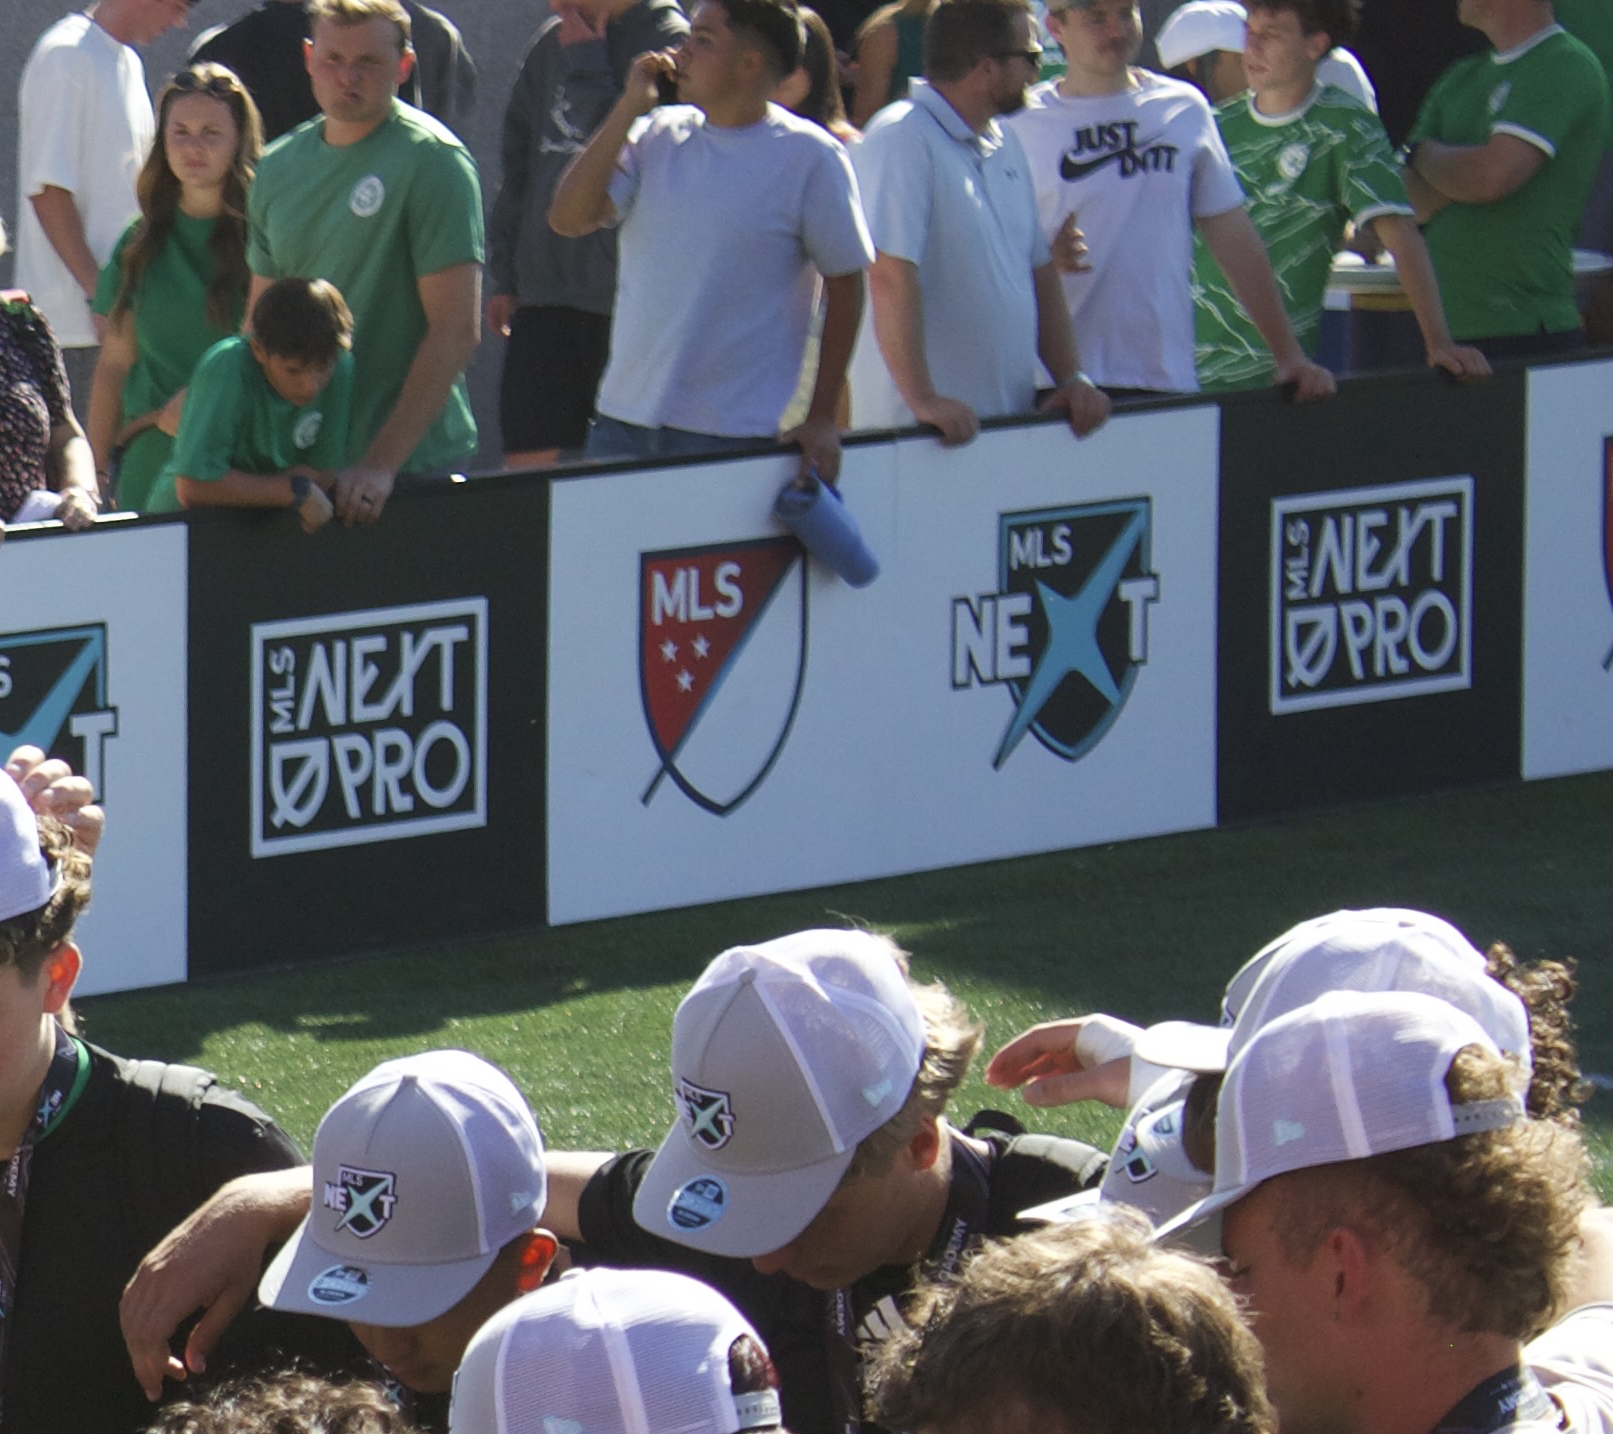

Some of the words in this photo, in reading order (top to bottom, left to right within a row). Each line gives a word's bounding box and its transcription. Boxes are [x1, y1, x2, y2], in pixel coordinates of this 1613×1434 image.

[1072, 121, 1139, 156] JUST
[1009, 523, 1074, 571] MLS
[1285, 518, 1310, 601] MLS
[1308, 500, 1458, 598] NEXT
[651, 560, 744, 627] MLS
[951, 574, 1160, 691] NEXT
[1339, 588, 1459, 680] PRO
[268, 645, 296, 735] MLS
[296, 623, 470, 731] NEXT
[331, 718, 471, 821] PRO
